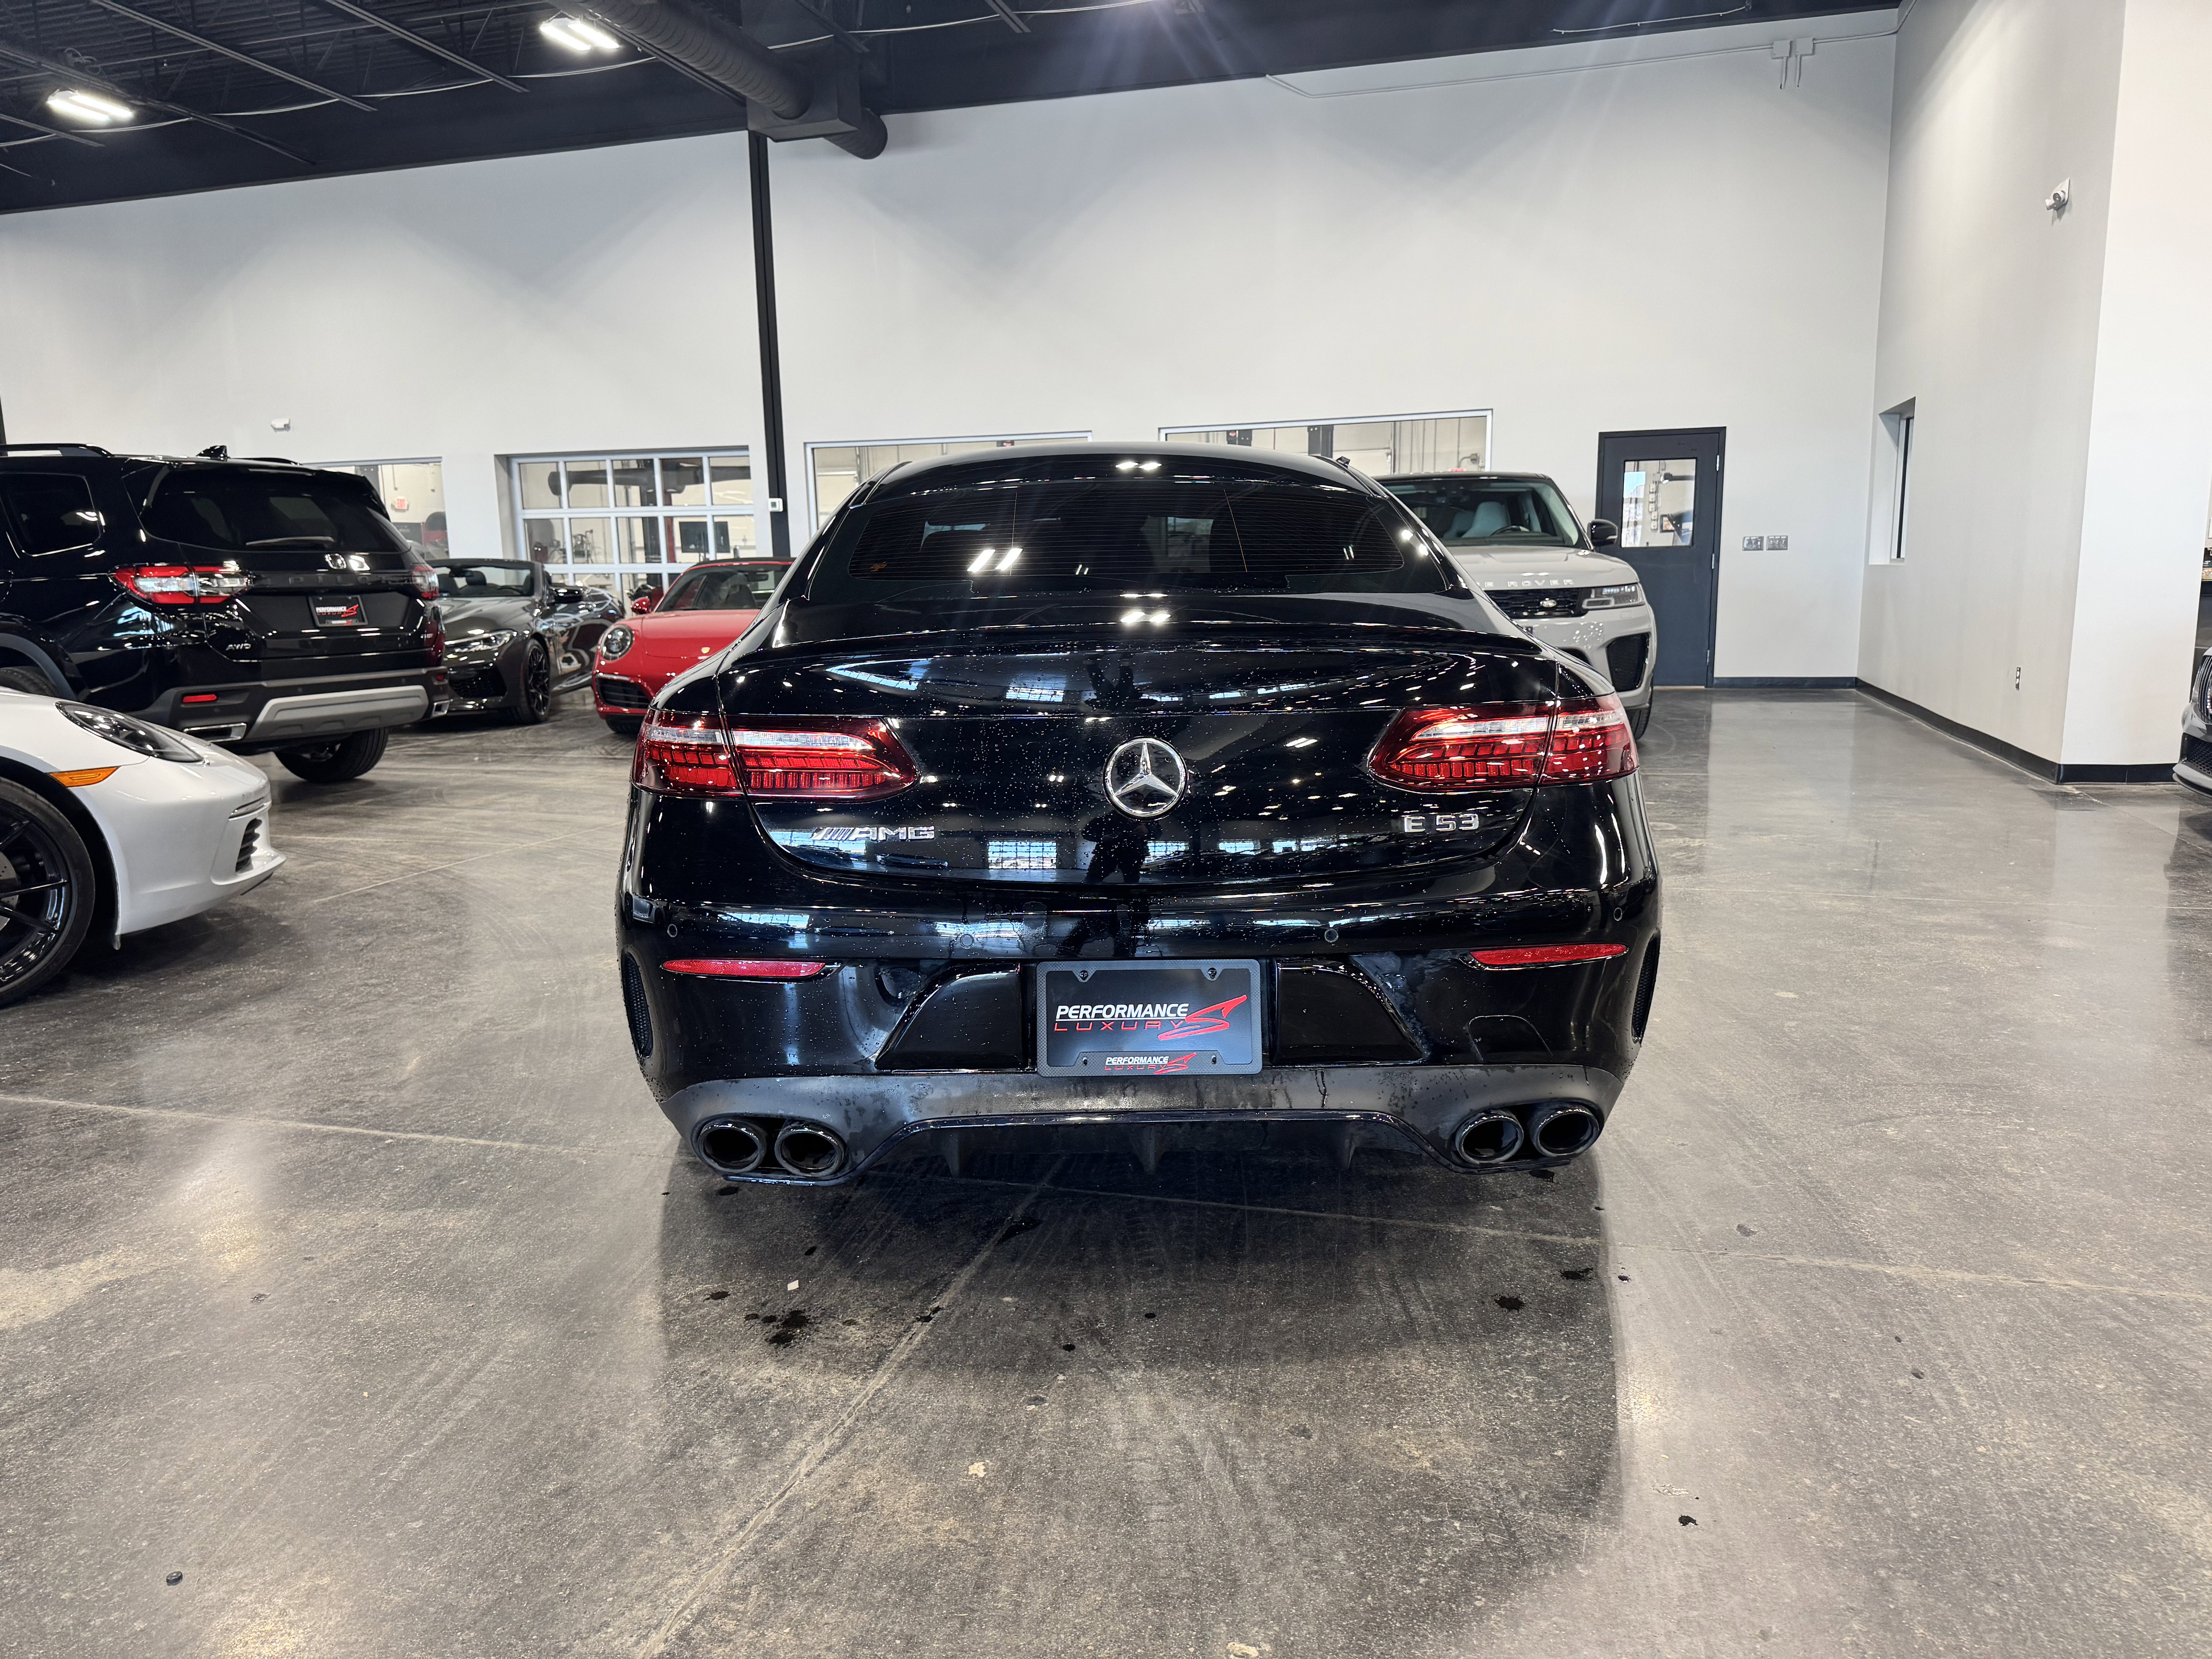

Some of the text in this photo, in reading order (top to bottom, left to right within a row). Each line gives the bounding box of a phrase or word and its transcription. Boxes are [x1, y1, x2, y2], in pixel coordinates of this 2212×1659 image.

[1405, 813, 1479, 833] E 53
[848, 826, 935, 841] AMG
[1056, 1003, 1189, 1019] PERFORMANCE
[1054, 1020, 1184, 1031] LUXURY
[1106, 1056, 1169, 1065] PERFORMANCE
